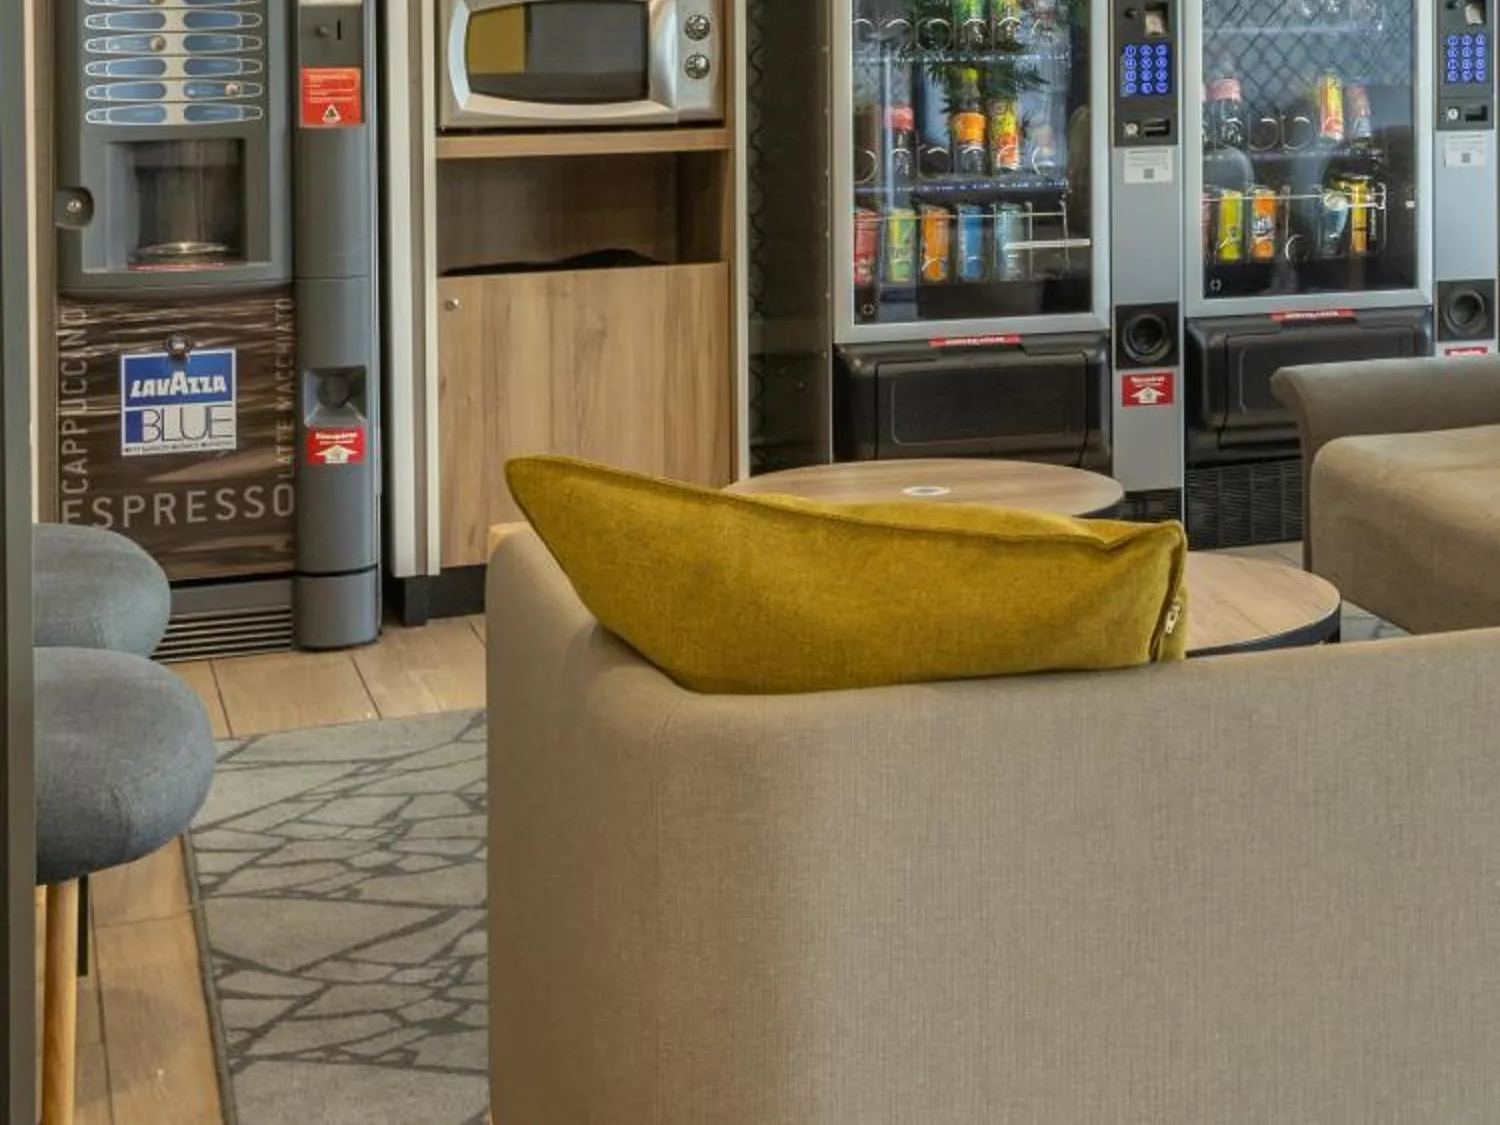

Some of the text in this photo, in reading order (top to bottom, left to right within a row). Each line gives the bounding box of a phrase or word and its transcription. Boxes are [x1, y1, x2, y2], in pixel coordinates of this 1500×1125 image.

[60, 308, 88, 495] CAPPUCCINO
[130, 371, 227, 398] LAVAZZA
[127, 404, 233, 444] BLUE
